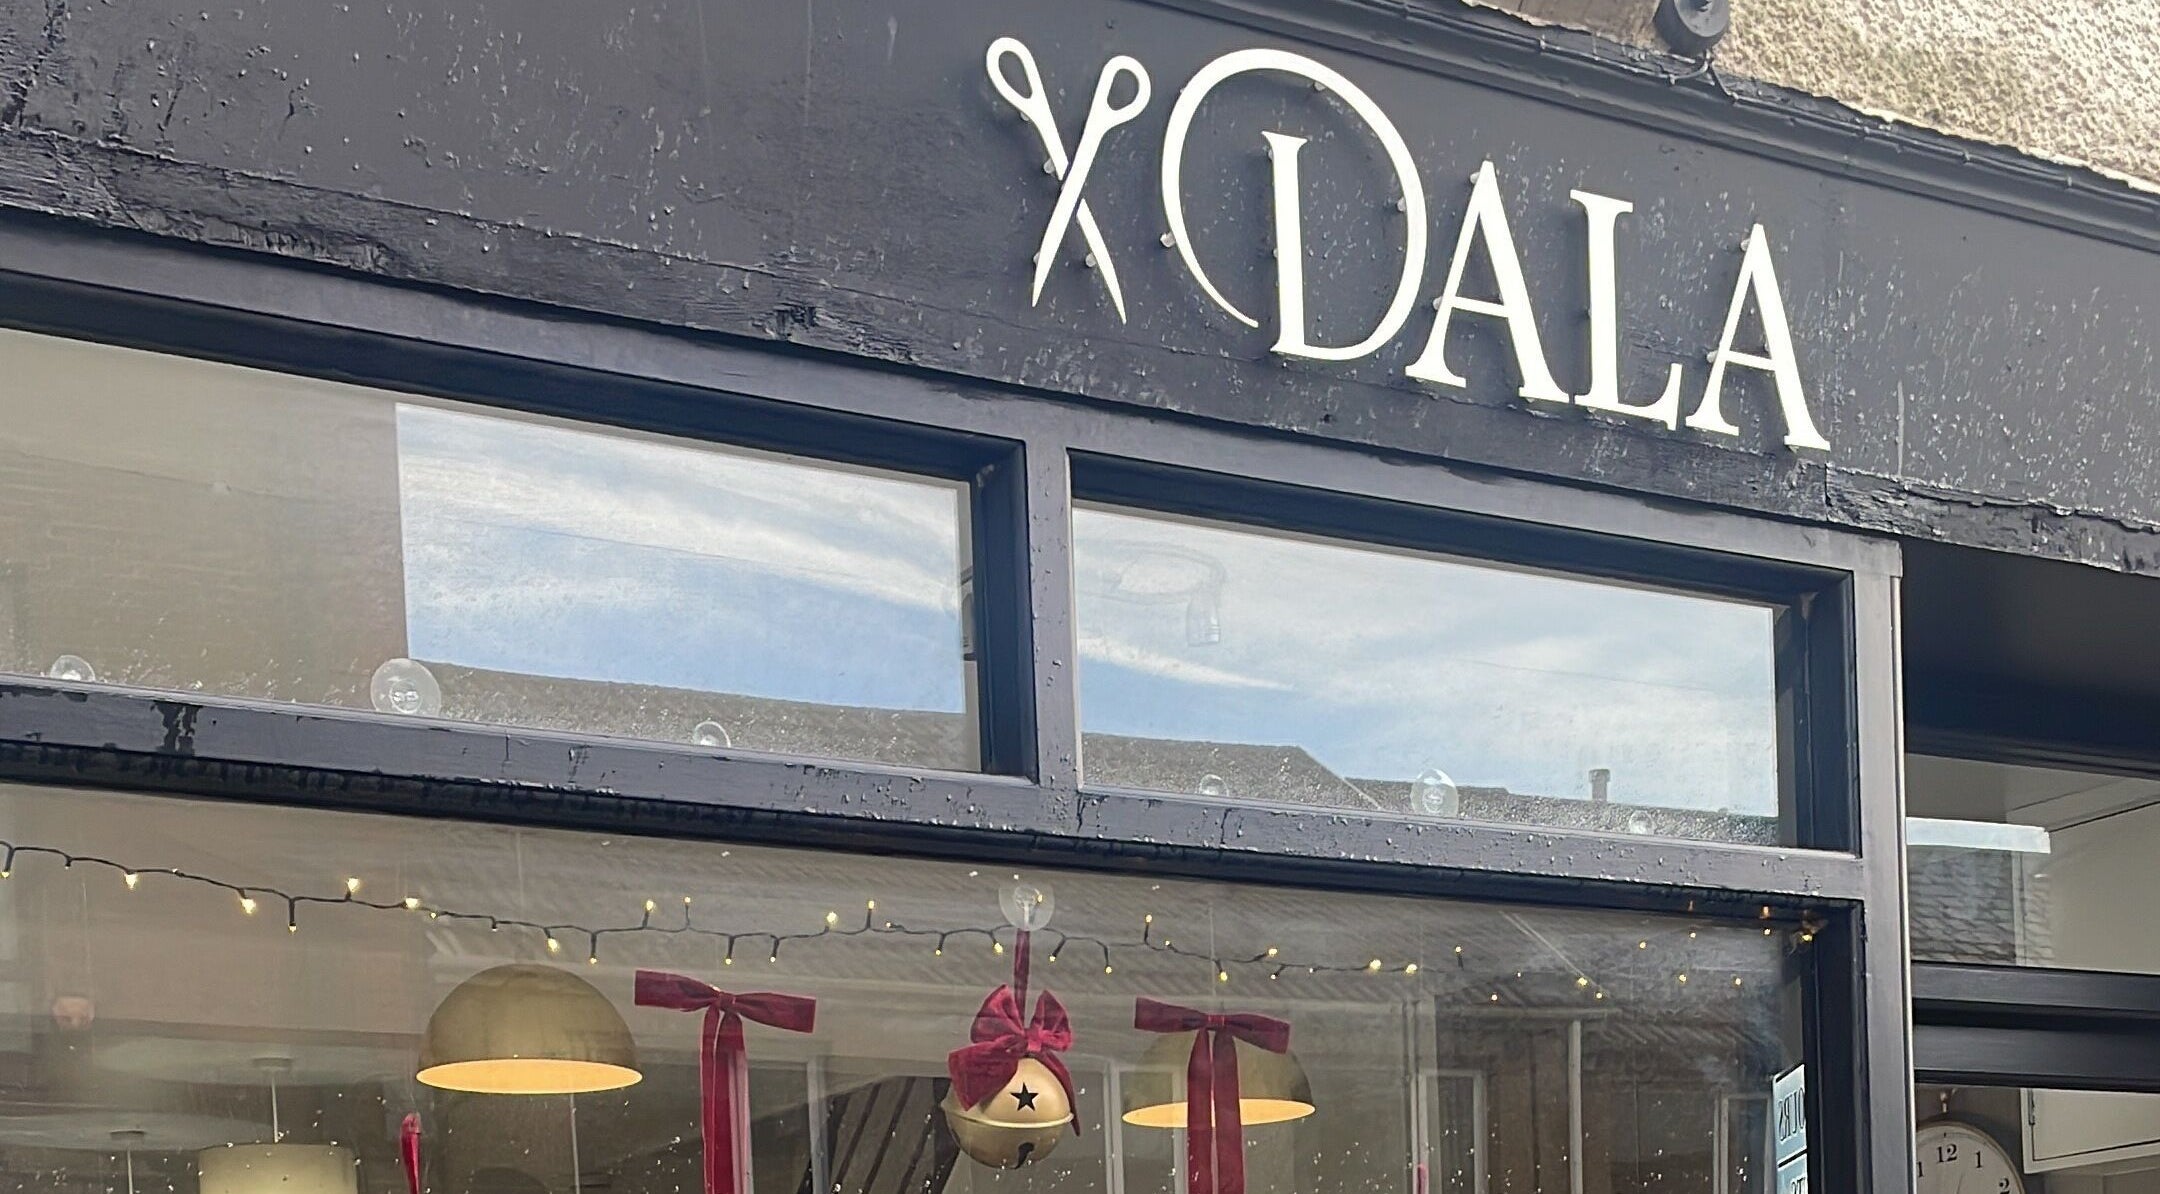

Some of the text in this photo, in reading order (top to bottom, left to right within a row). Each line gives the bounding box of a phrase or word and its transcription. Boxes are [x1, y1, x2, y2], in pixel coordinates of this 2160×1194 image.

[1162, 48, 1830, 451] DALA
[1936, 1143, 1958, 1163] 12
[1974, 1150, 1983, 1168] 1
[1998, 1178, 2011, 1194] 2
